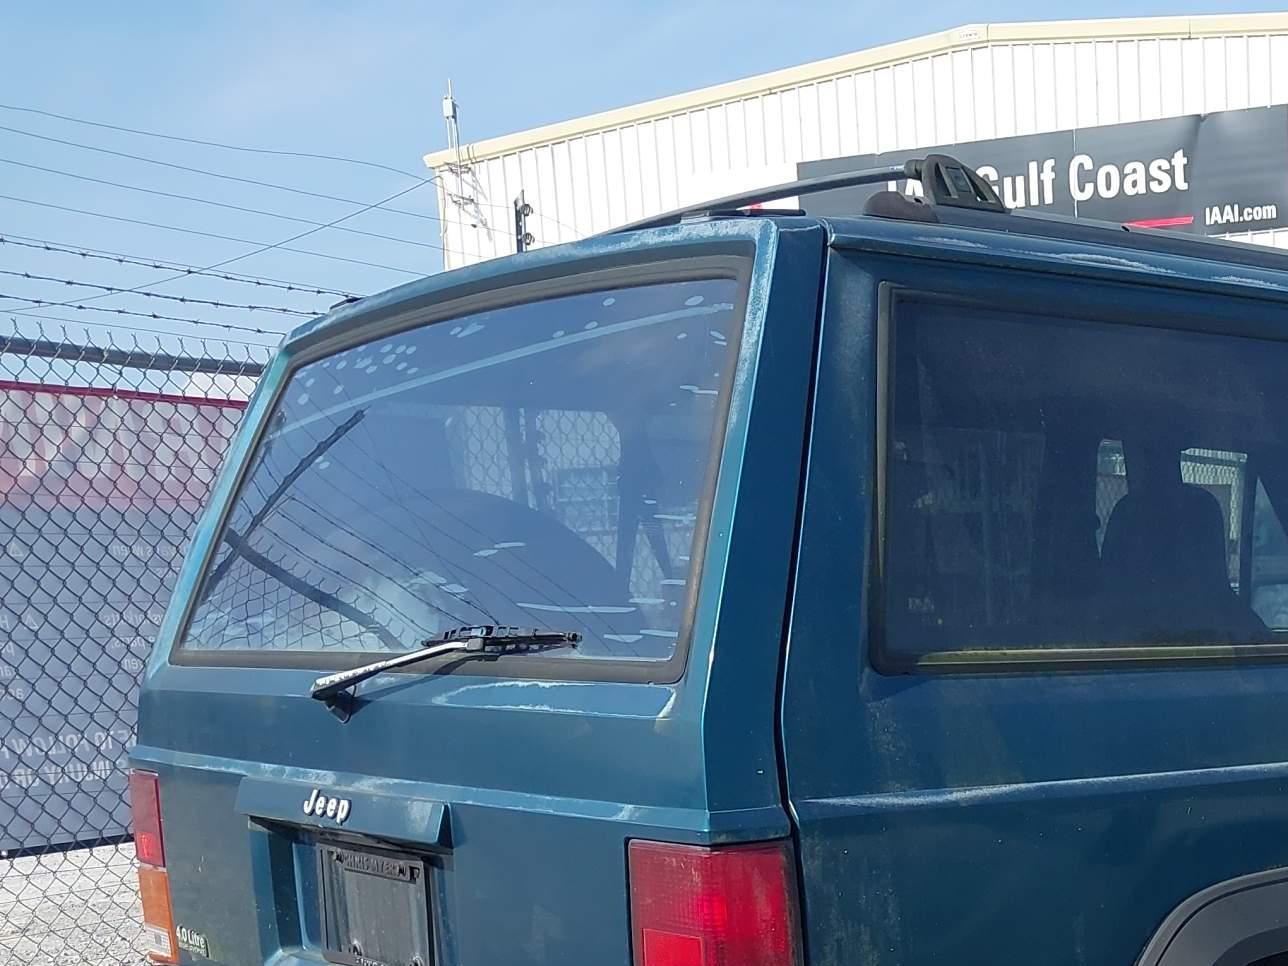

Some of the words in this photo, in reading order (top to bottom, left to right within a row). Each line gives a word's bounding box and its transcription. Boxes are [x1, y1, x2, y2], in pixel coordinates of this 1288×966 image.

[1069, 149, 1188, 200] Coast
[1205, 205, 1277, 225] IAAI.com
[304, 789, 352, 824] Jeep
